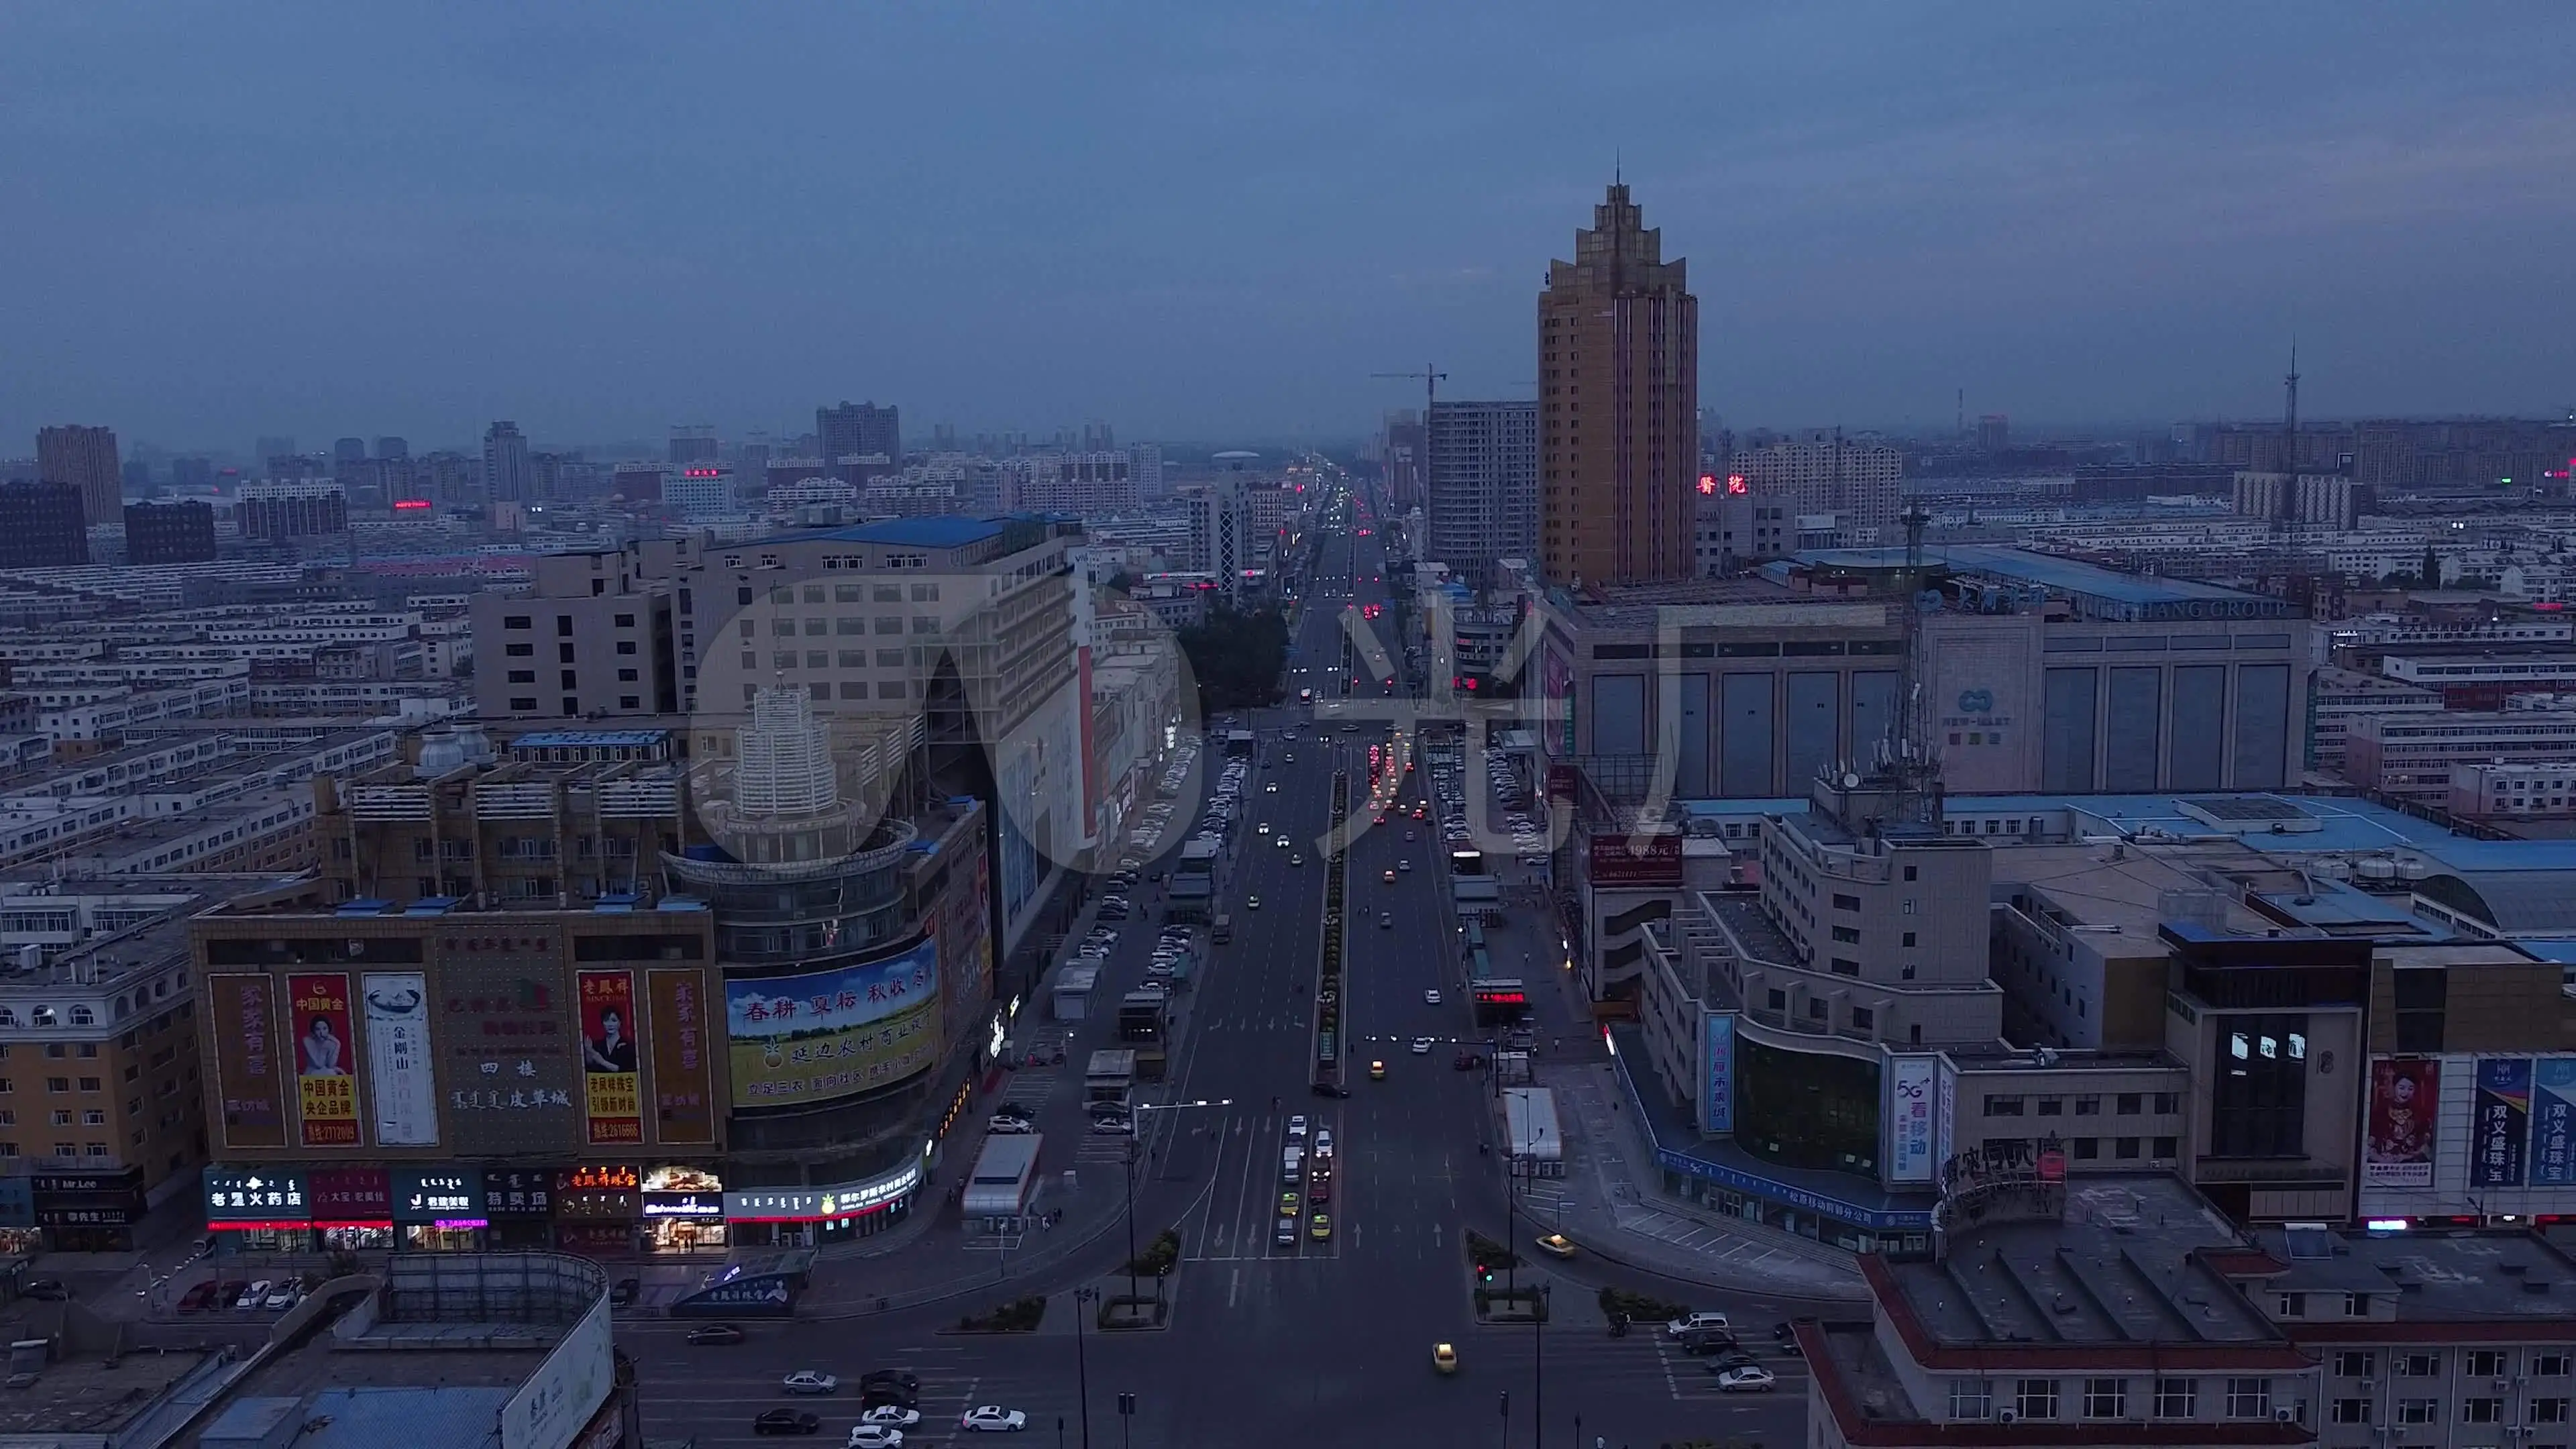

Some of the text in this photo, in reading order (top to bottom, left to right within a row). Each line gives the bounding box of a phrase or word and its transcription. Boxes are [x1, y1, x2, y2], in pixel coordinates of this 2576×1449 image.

[2210, 600, 2287, 617] GROUP
[296, 998, 344, 1011] 中国黄金
[745, 1000, 796, 1021] 春耕
[867, 978, 906, 1004] 秋收
[304, 1079, 350, 1097] 中国黄金
[749, 1081, 804, 1095] 立足三农
[306, 1099, 352, 1115] 央企品牌
[2488, 1105, 2508, 1182] 双义盛珠宝
[2546, 1104, 2567, 1181] 双义盛珠宝
[62, 1179, 97, 1189] Mr.Lee
